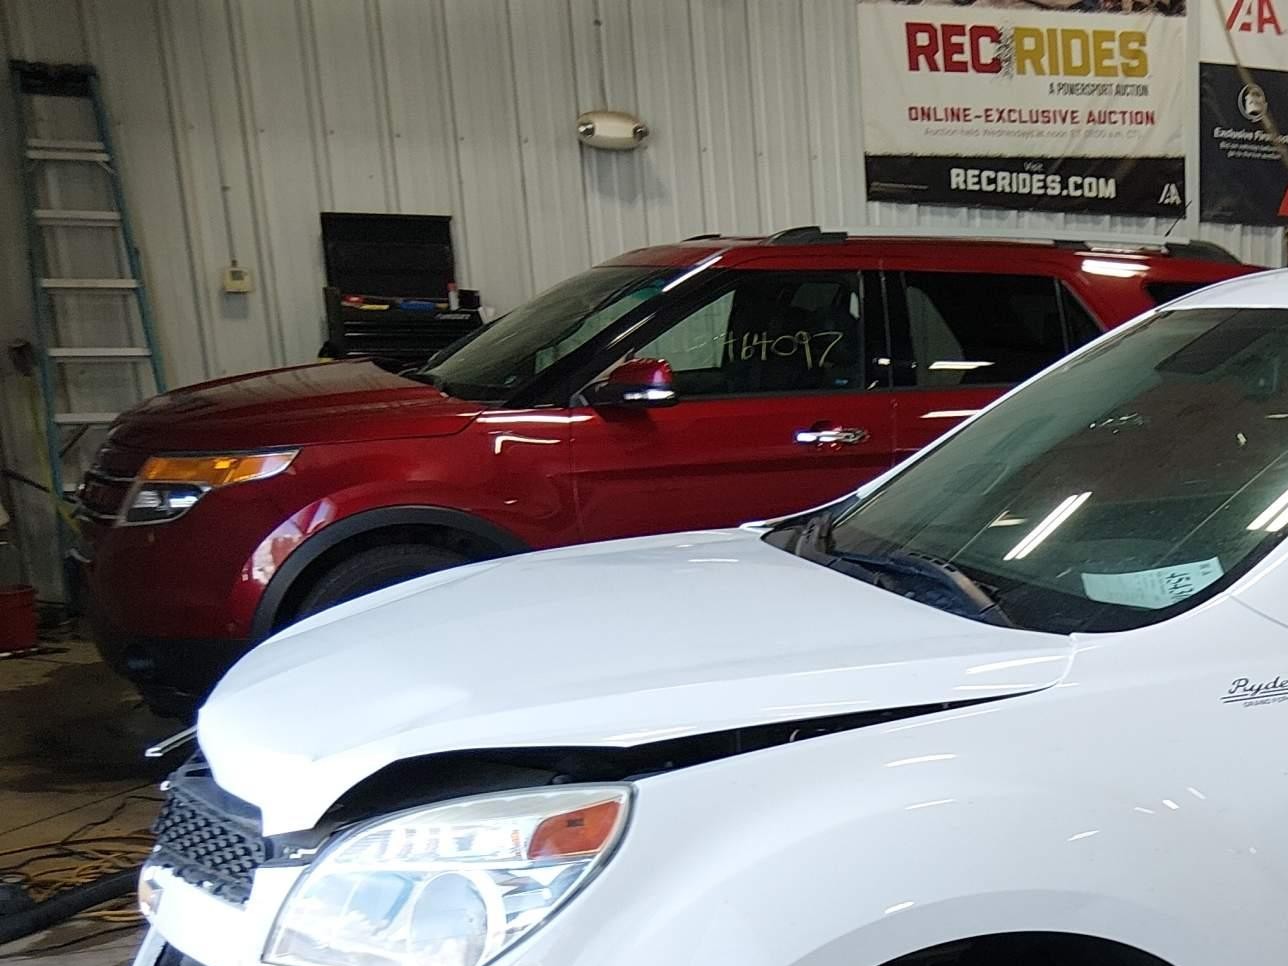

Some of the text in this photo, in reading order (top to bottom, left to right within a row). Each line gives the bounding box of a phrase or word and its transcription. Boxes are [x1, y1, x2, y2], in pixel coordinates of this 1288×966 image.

[1114, 83, 1149, 97] AUCTION
[908, 106, 1156, 126] ONLINE-EXCLUSIVE AUCTION
[950, 167, 1116, 199] RECRIDES.COM
